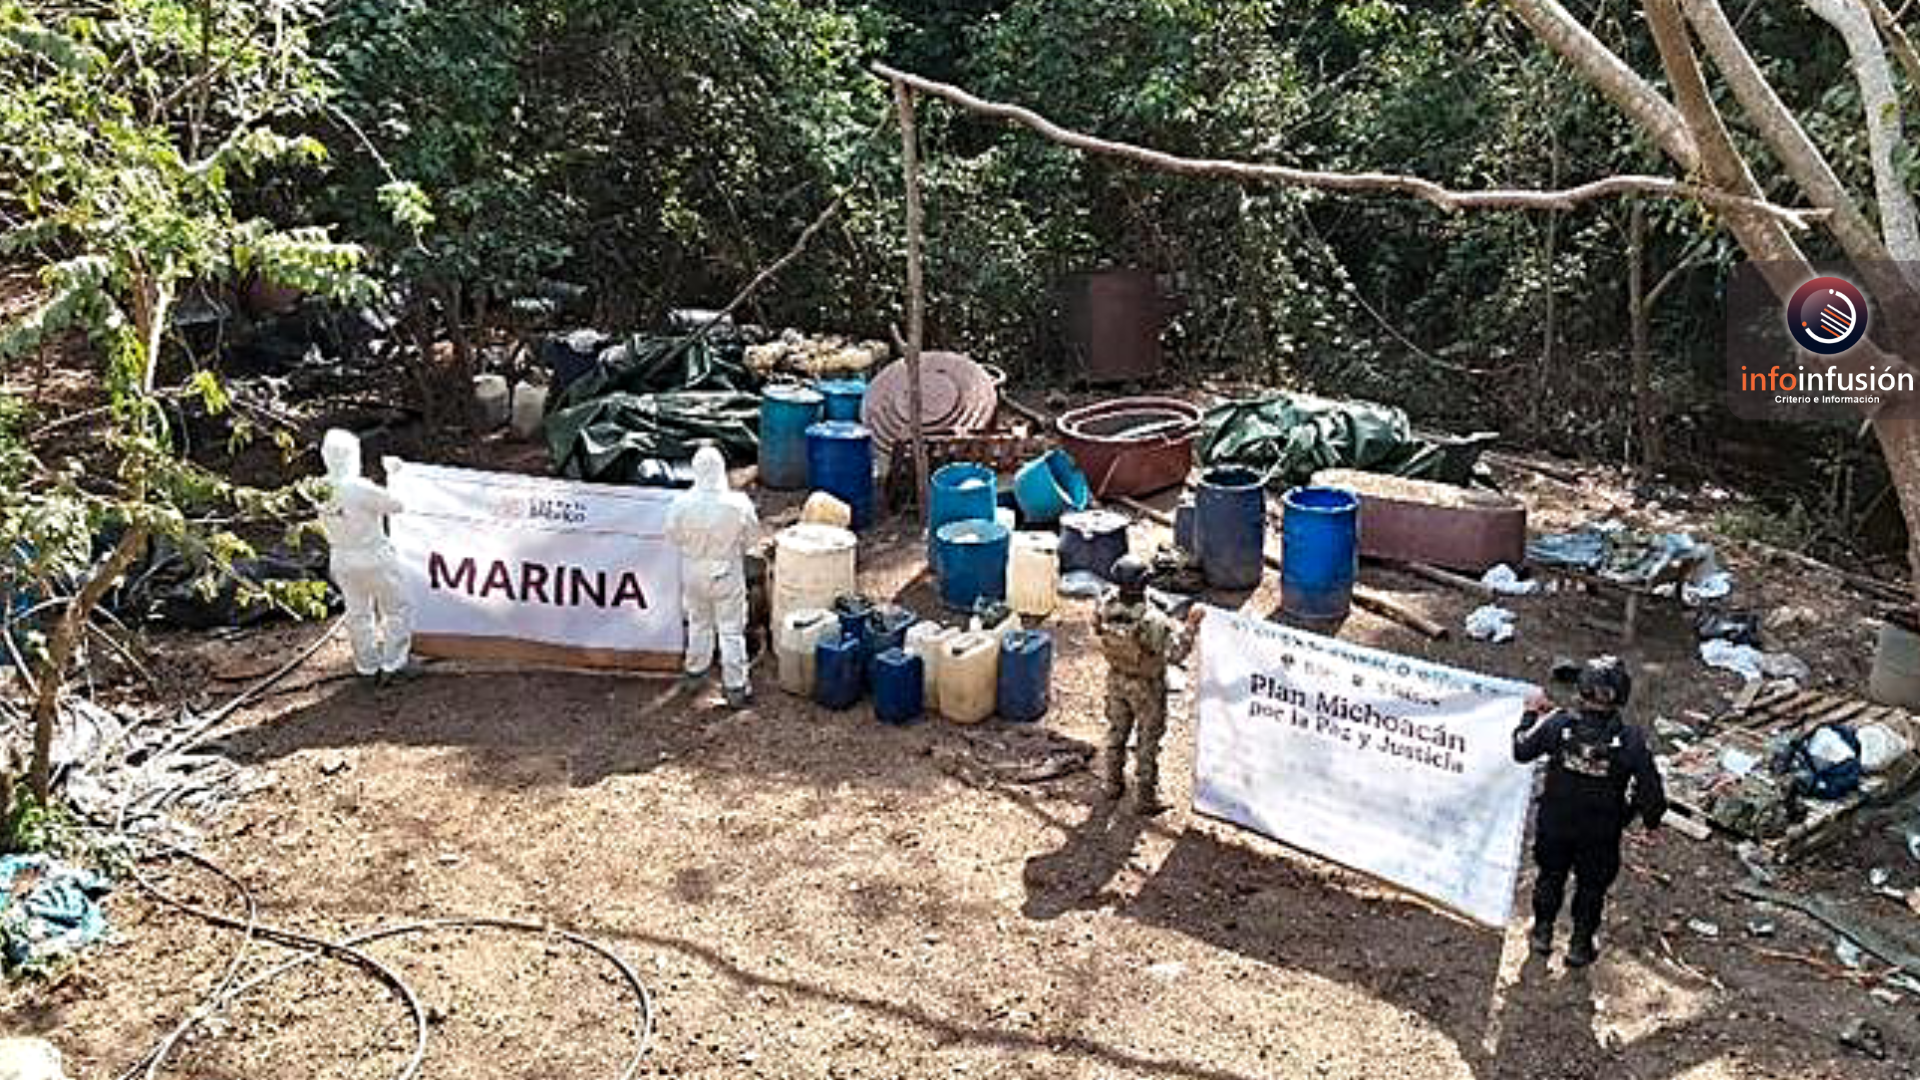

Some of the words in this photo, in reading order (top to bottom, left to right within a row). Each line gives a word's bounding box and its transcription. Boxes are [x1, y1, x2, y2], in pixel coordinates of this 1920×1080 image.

[428, 551, 648, 609] MARINA
[1249, 700, 1284, 722] por
[1290, 709, 1309, 729] la
[1358, 731, 1371, 750] y
[1376, 735, 1464, 774] Justicia
[1250, 673, 1307, 708] Plan
[1316, 692, 1465, 753] Michoacán
